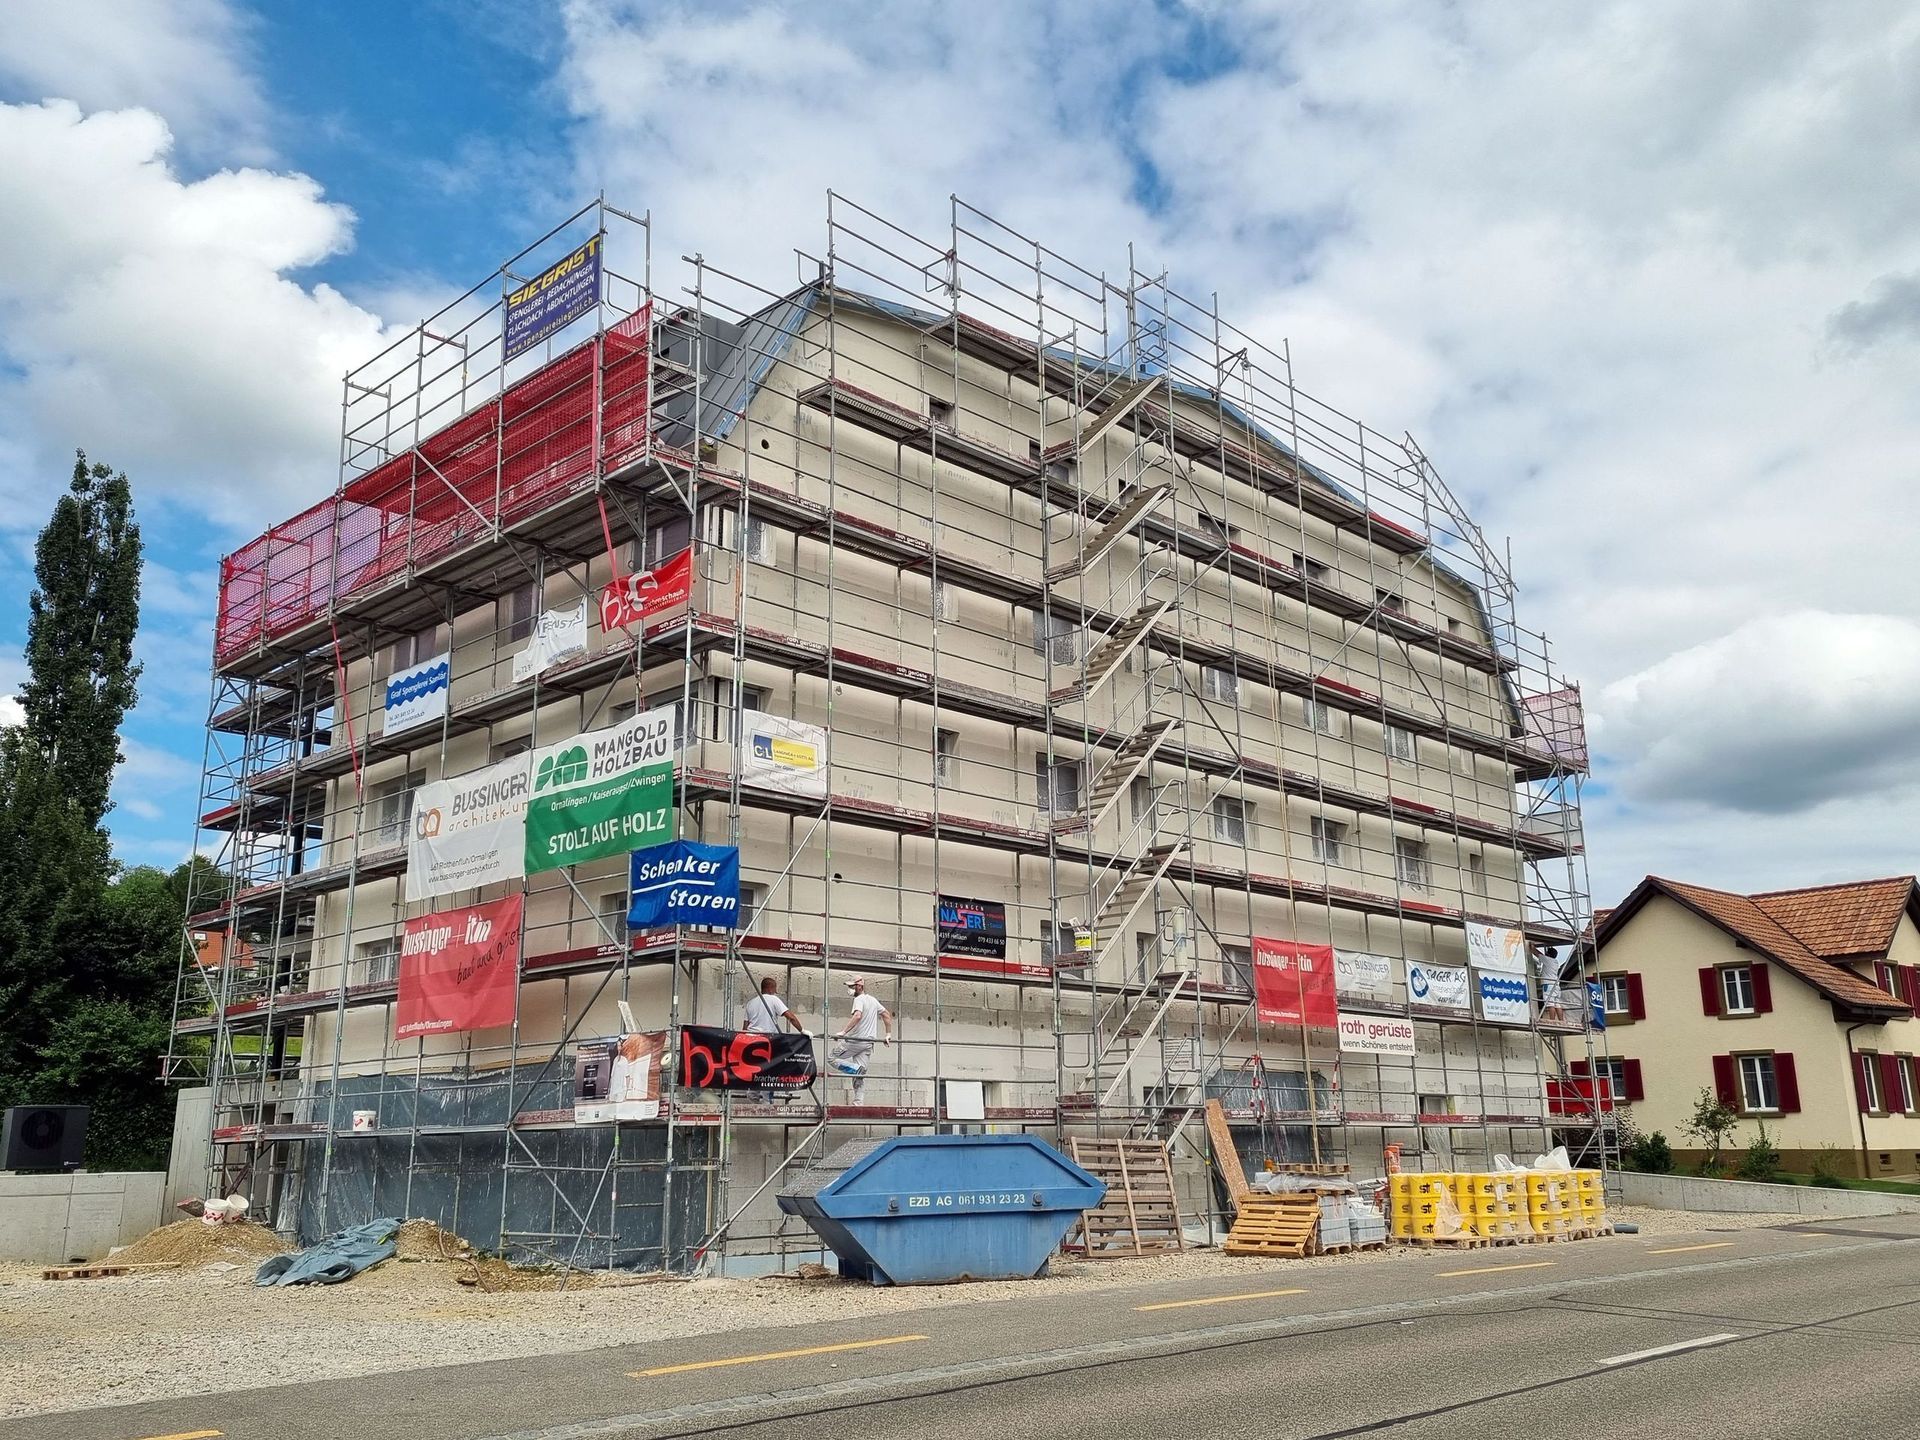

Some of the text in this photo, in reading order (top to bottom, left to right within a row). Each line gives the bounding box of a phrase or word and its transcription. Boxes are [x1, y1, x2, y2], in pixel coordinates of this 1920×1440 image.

[508, 236, 600, 310] SIEGRIST
[508, 296, 543, 325] SPENGLEREI
[547, 261, 594, 300] BEDACHUNGEN
[507, 308, 543, 337] FLACHDACH
[545, 273, 595, 313] ABDICHTUNGEN
[594, 719, 668, 760] MANGOLD
[592, 738, 667, 779] HOLZBAU
[452, 771, 528, 817] BUSSINGER
[548, 808, 666, 855] STOLZ AUF HOLZ
[640, 855, 720, 881] Schenker
[668, 889, 736, 910] Storen
[940, 908, 984, 930] NASER
[402, 923, 452, 957] bussinger
[794, 943, 817, 951] gerüste
[1426, 968, 1466, 982] SAGER AG
[1340, 1019, 1412, 1039] roth gerüste
[1343, 1039, 1414, 1051] wenn Schönes entsteht
[908, 1107, 929, 1115] gerüste
[1419, 1182, 1430, 1193] st
[909, 1193, 1025, 1207] EZB AG 061 931 23 23
[1421, 1203, 1432, 1213] st
